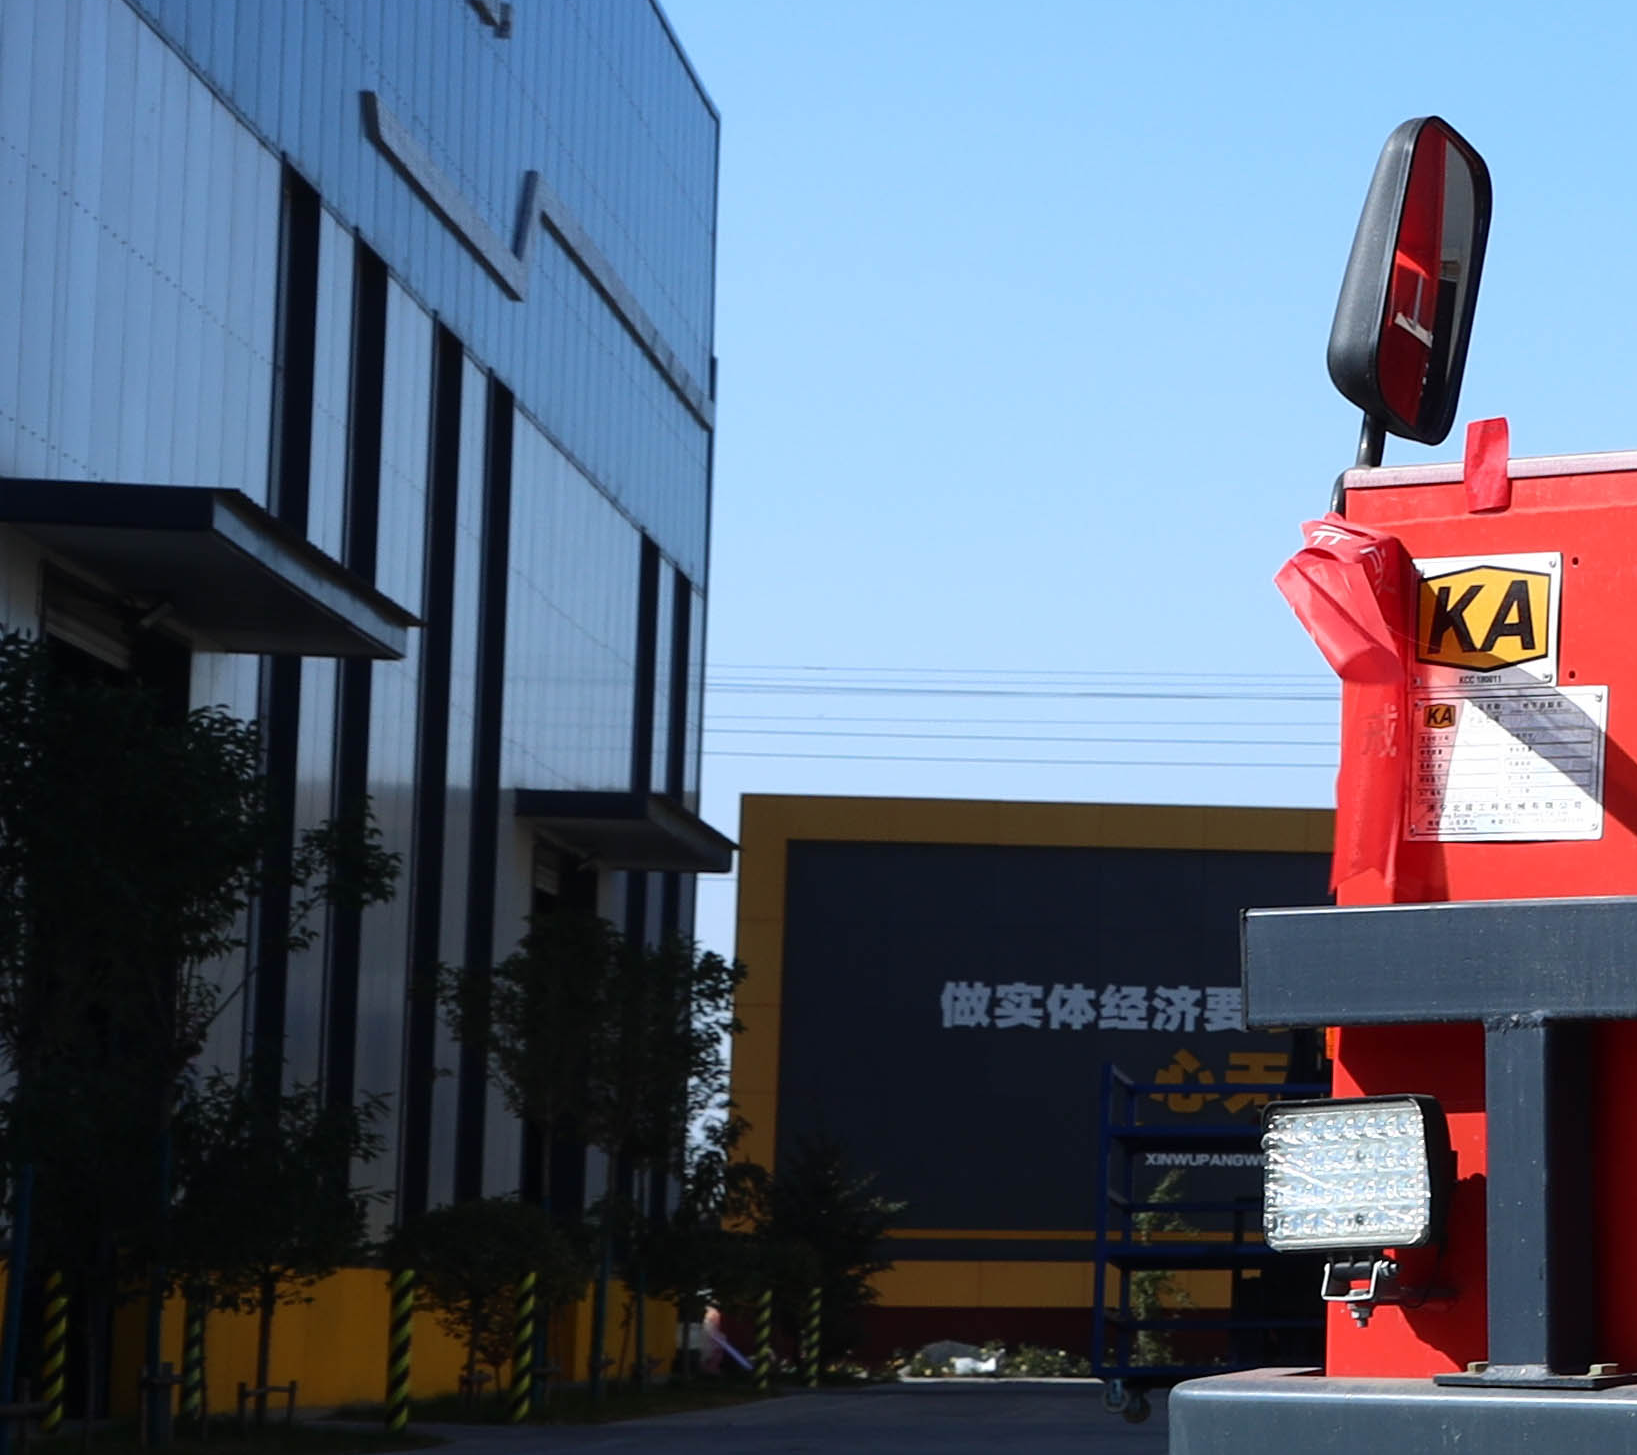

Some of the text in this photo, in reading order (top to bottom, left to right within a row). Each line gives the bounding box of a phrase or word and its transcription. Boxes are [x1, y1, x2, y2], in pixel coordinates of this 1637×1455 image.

[1428, 580, 1536, 653] KA
[1427, 707, 1453, 724] KA
[940, 981, 1242, 1032] 做实体经济要
